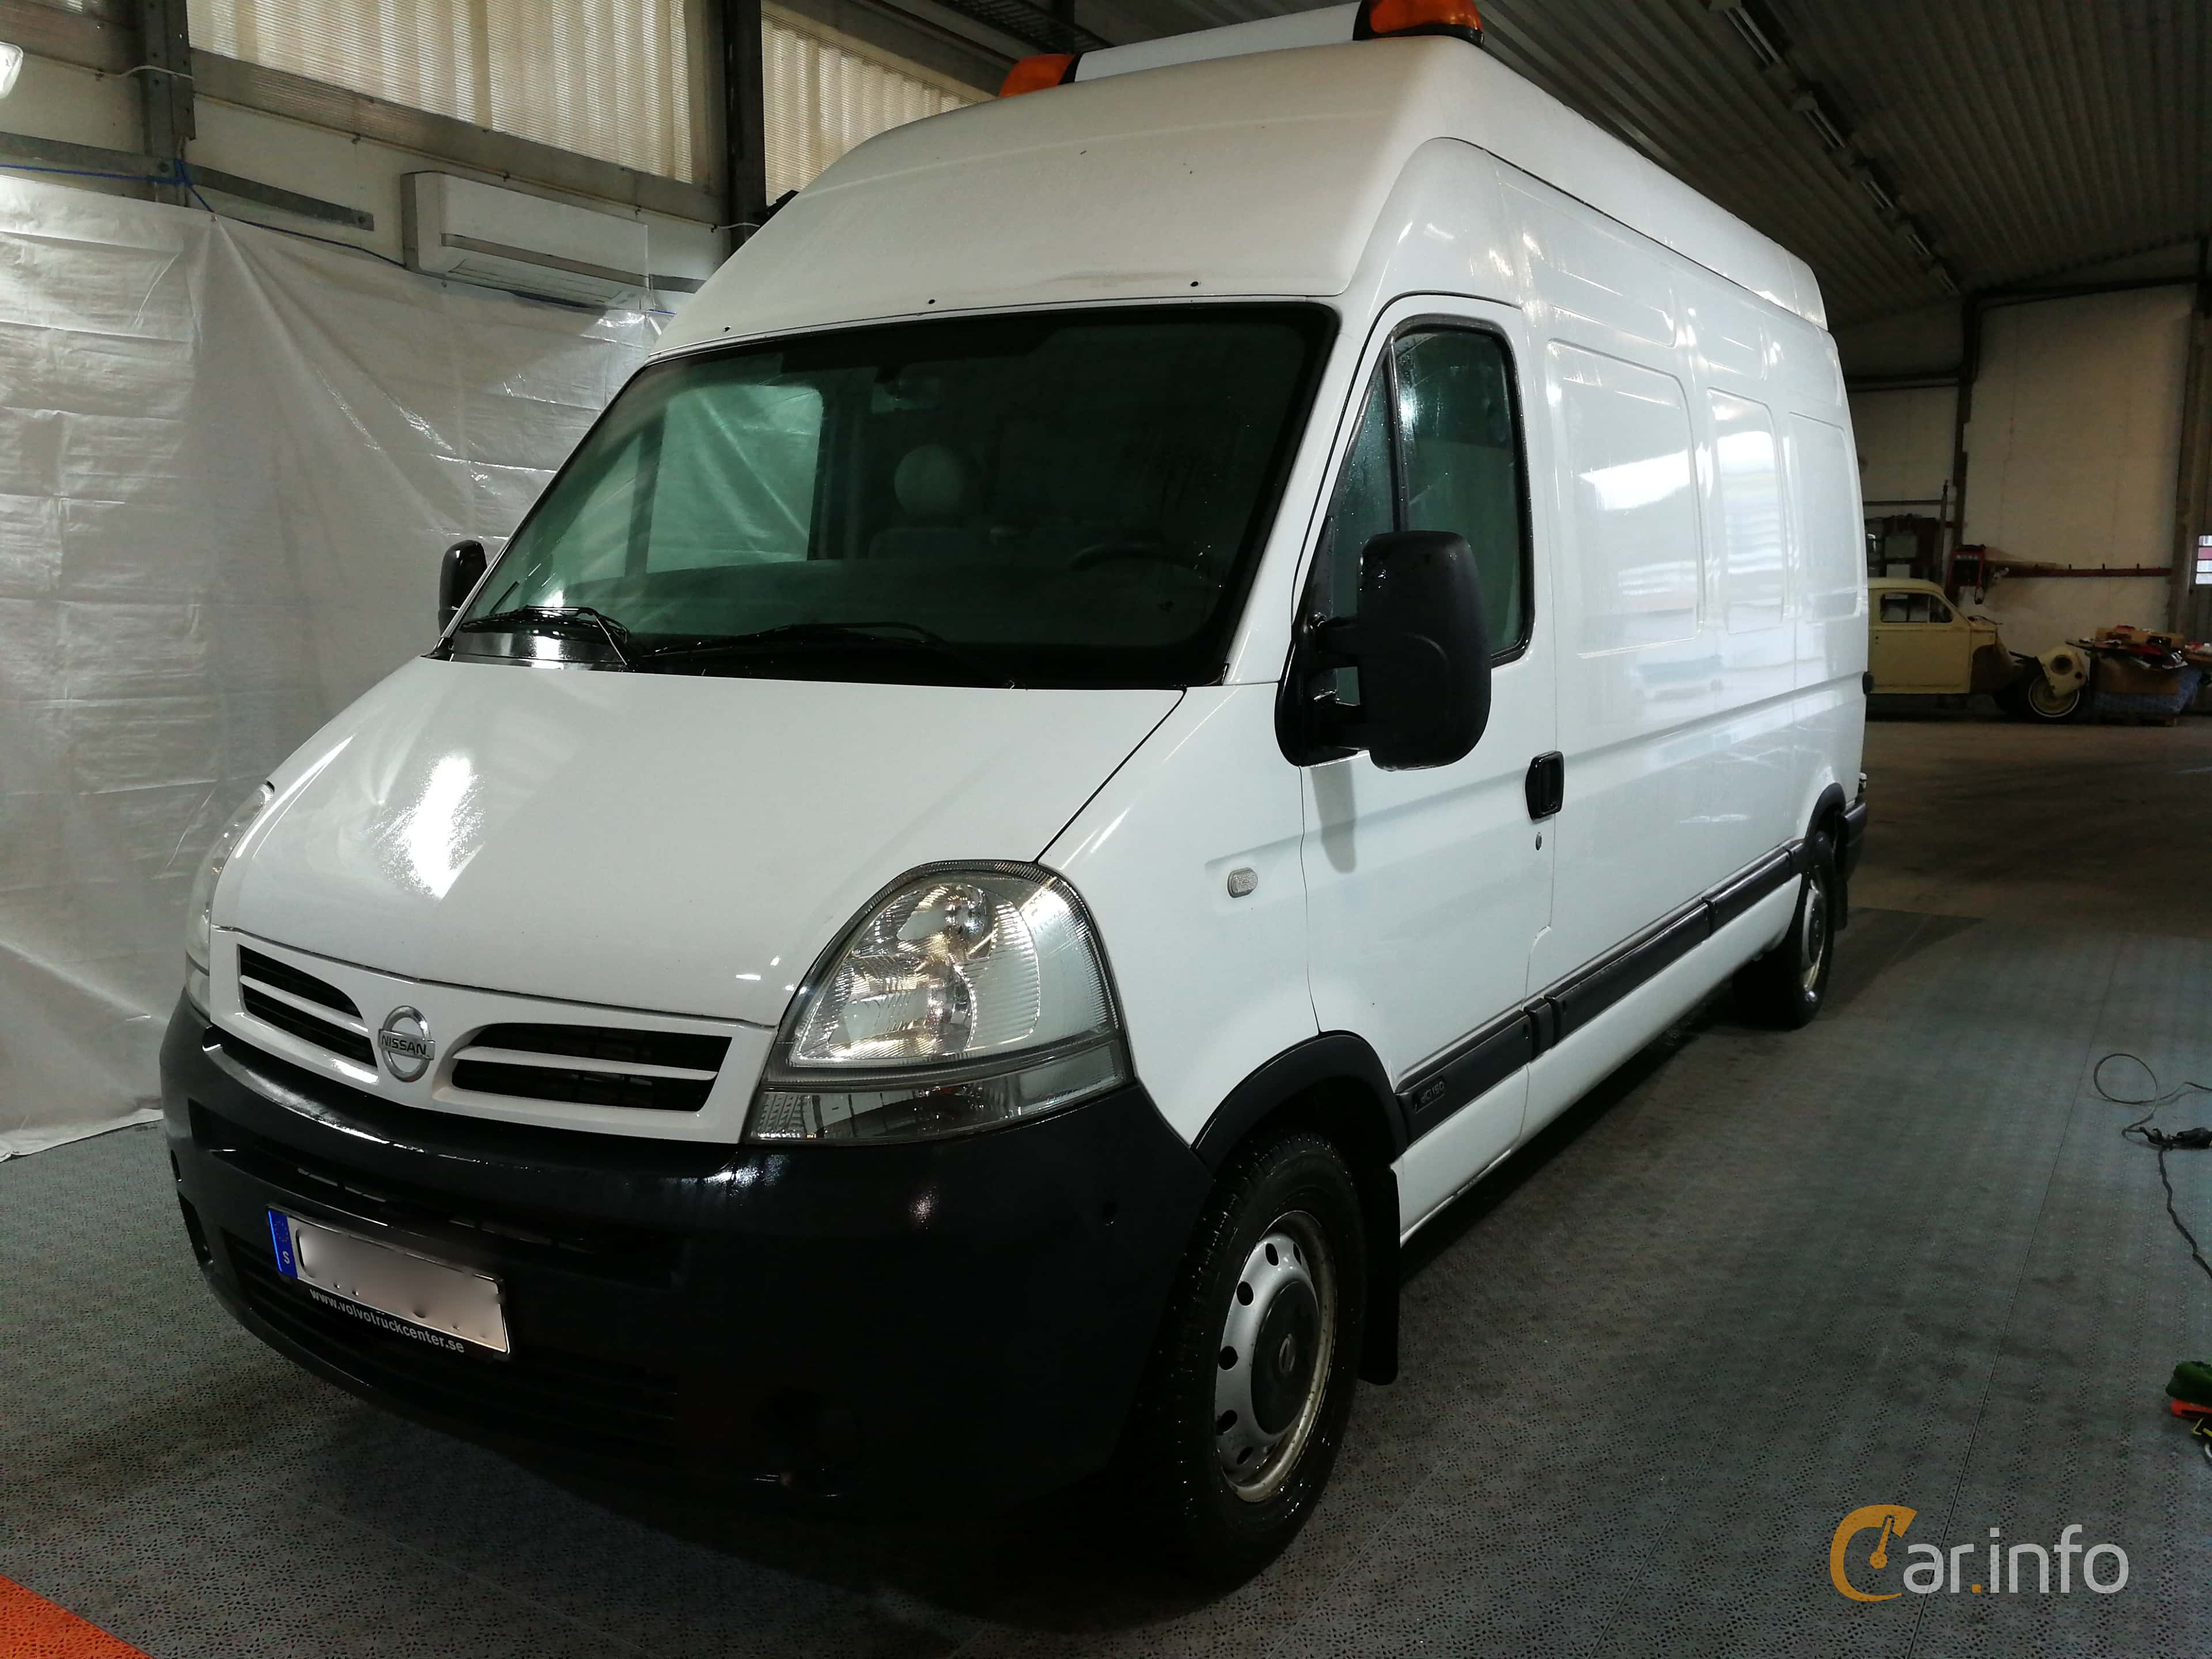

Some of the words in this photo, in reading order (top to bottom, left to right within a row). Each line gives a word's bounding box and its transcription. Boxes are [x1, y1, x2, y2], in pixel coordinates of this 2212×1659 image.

[381, 1035, 427, 1055] NISSAN
[282, 1251, 290, 1264] S
[309, 1288, 465, 1354] www.volvotruckcenter.se
